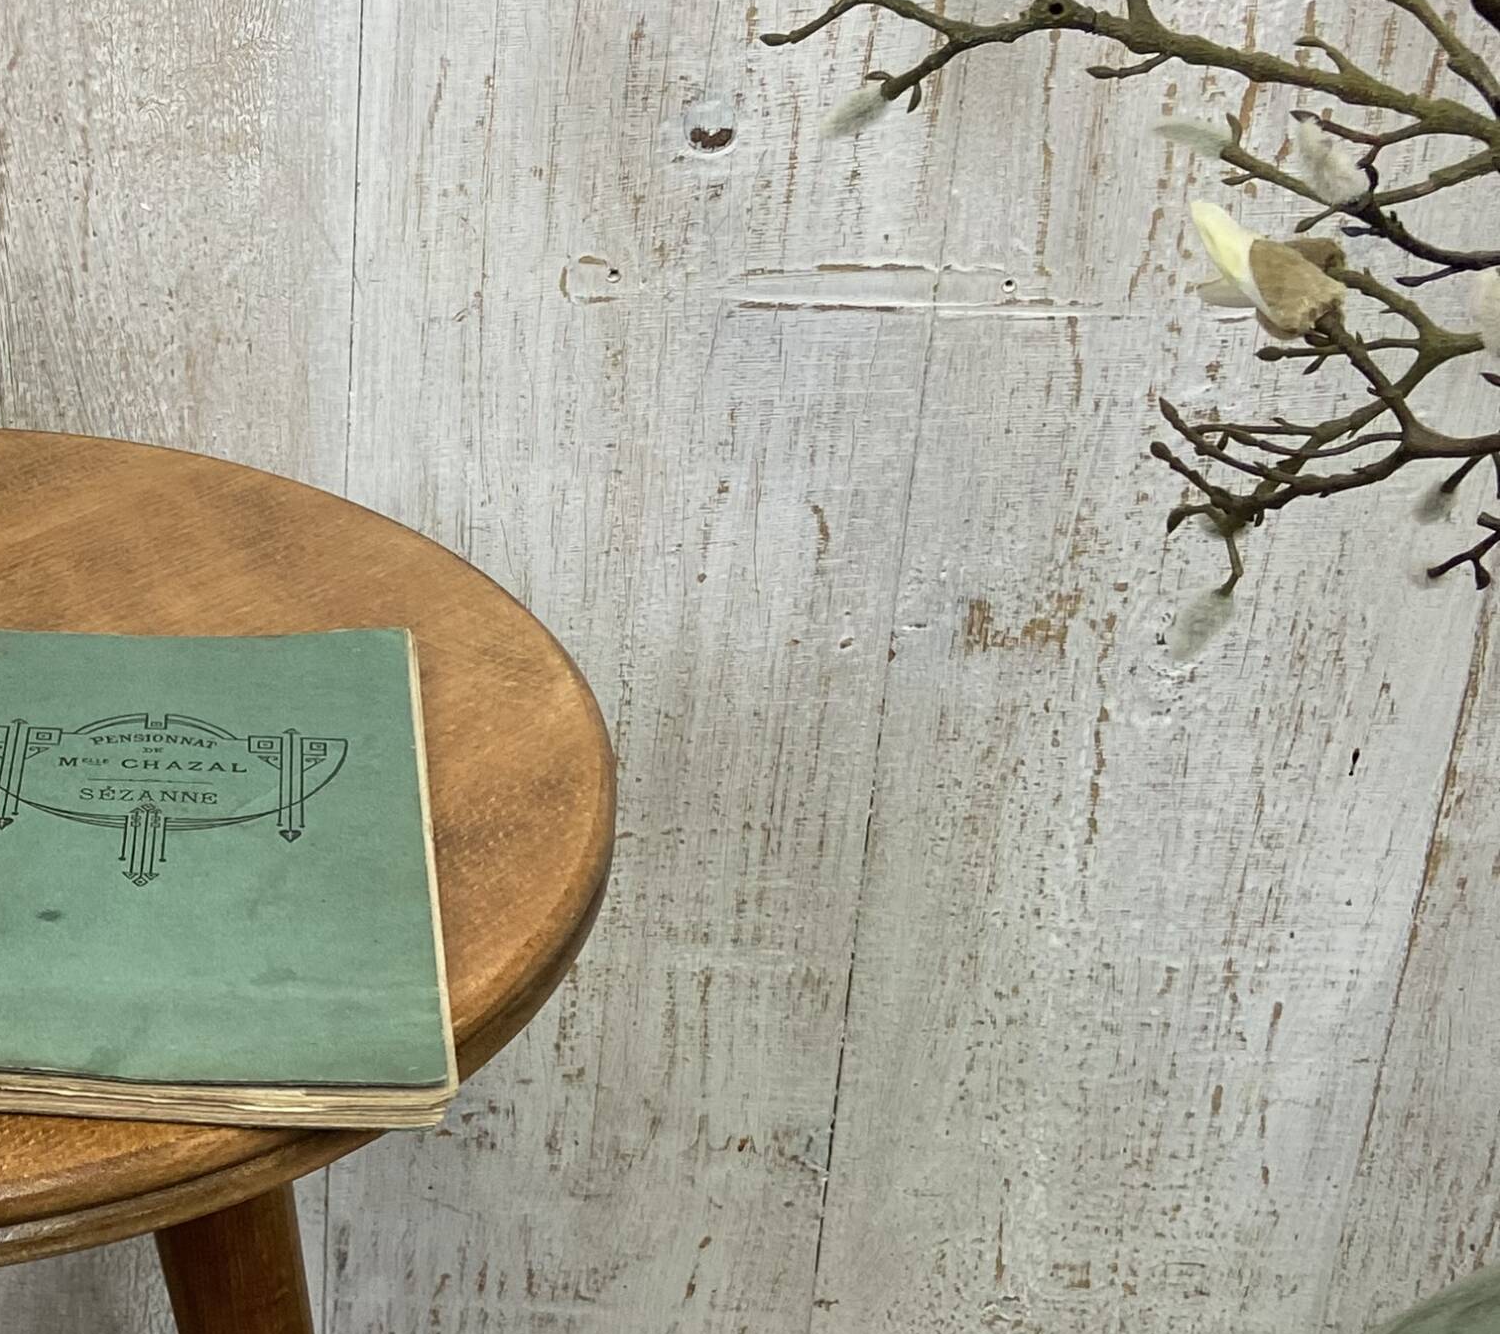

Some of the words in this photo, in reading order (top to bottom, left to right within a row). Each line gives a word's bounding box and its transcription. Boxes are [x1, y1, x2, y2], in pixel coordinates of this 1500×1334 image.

[90, 733, 218, 749] PENSIONNAT
[121, 758, 248, 773] CHAZAL
[79, 786, 219, 805] SÉZANNE
